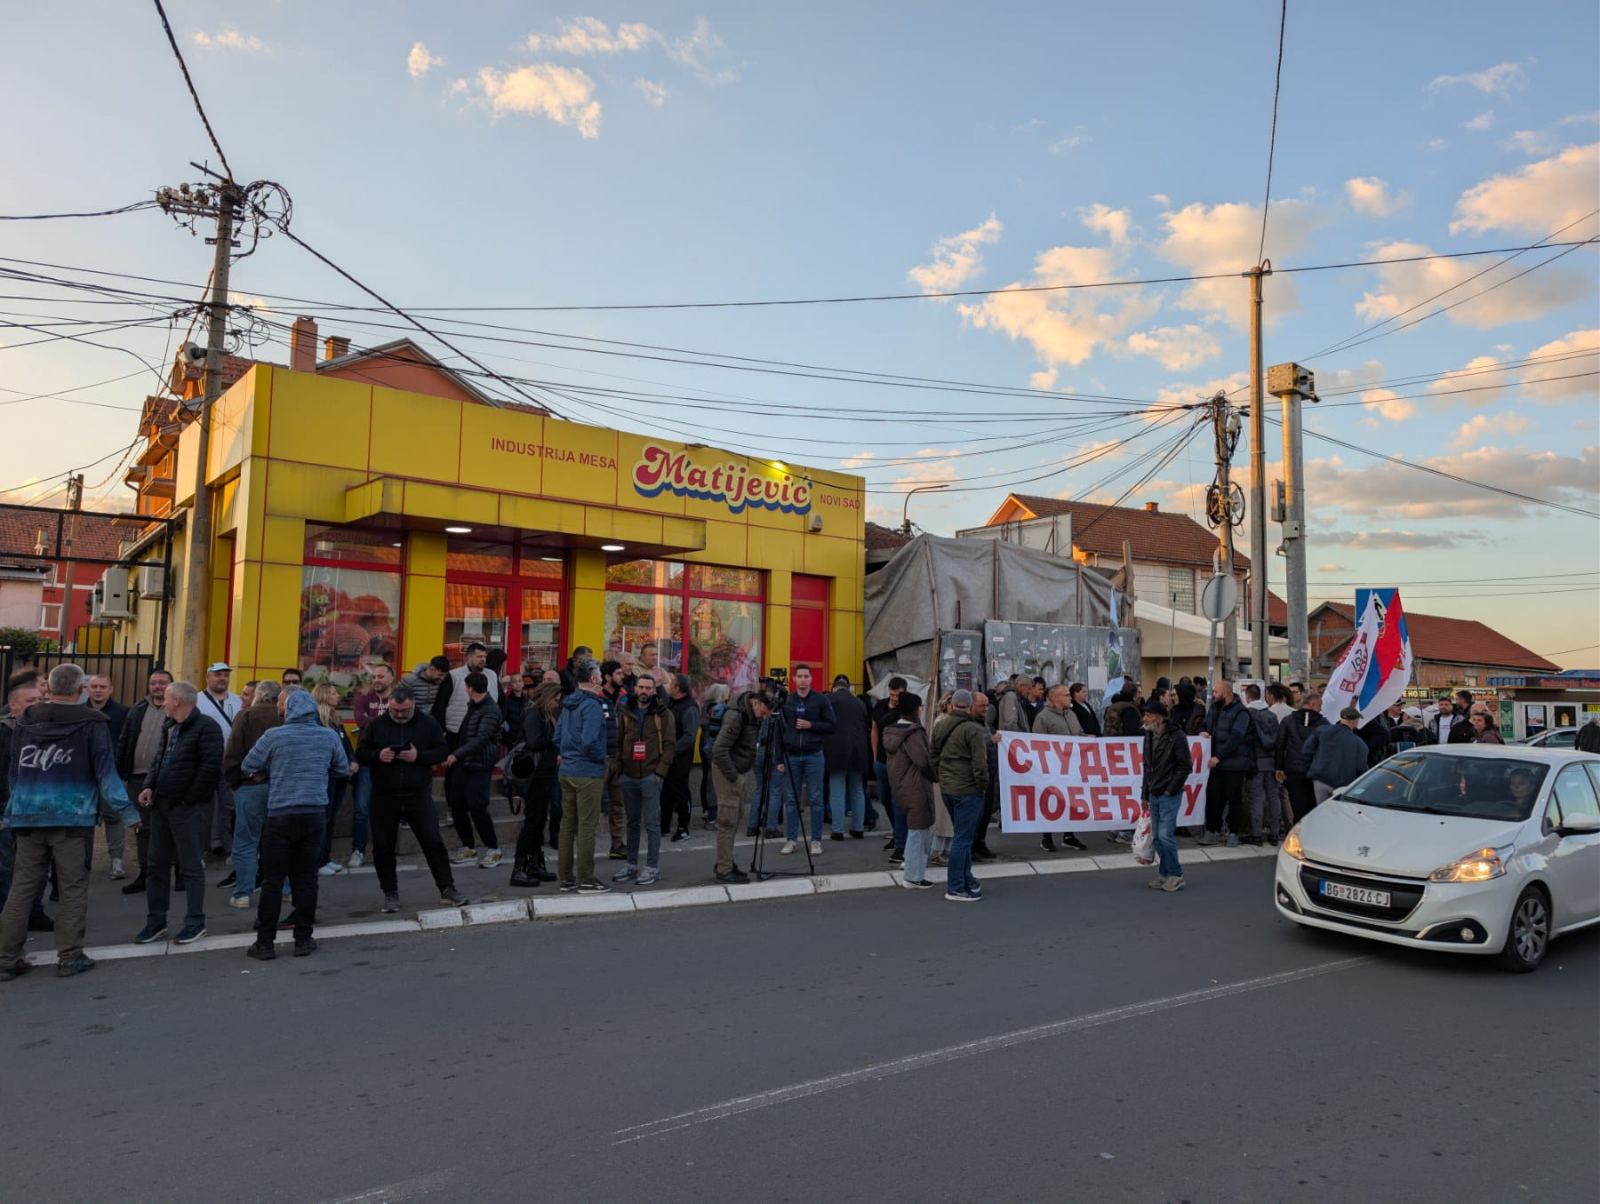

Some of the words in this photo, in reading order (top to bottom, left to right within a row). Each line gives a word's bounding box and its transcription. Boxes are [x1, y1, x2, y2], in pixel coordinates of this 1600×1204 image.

[491, 437, 575, 463] INDUSTRIJA
[579, 452, 617, 470] MESA
[820, 494, 841, 507] NOVI
[843, 497, 861, 509] SAD
[1008, 738, 1203, 783] СТУДЕНИ
[1326, 883, 1339, 897] BG
